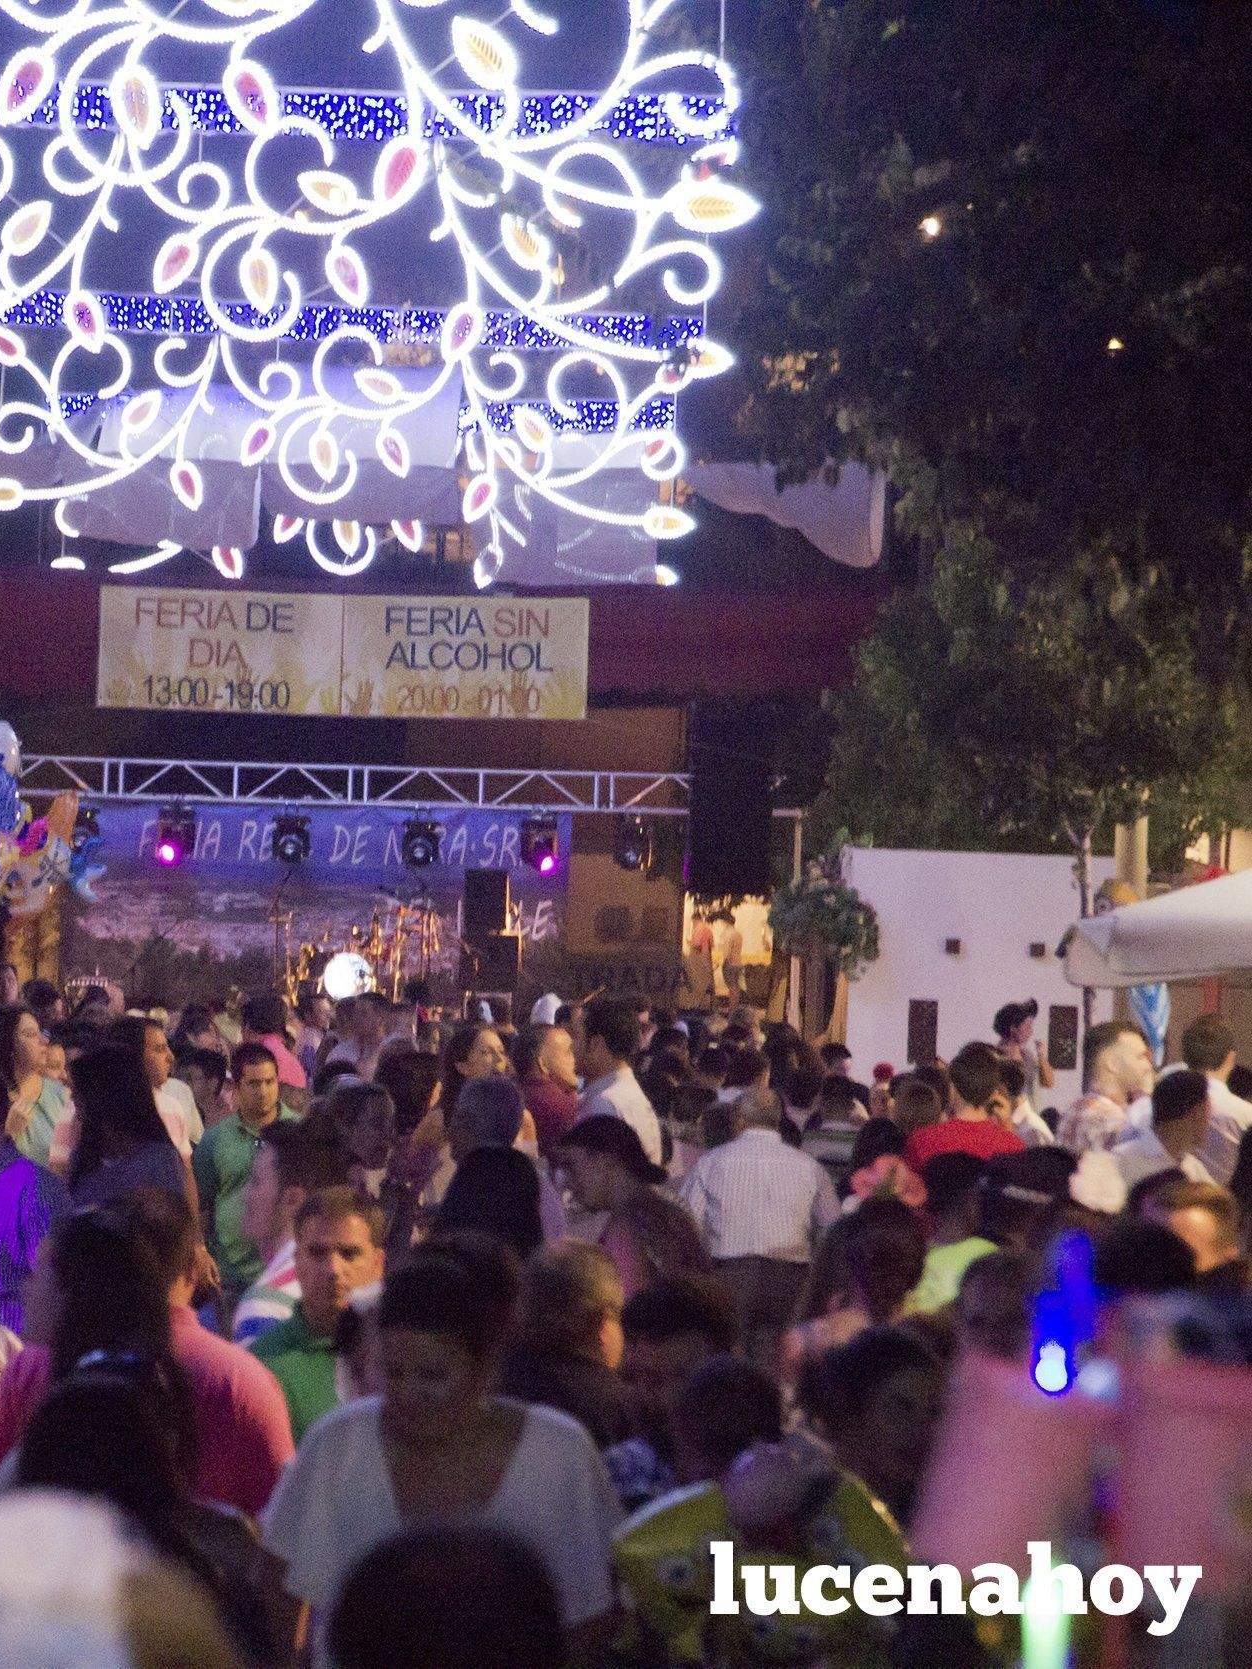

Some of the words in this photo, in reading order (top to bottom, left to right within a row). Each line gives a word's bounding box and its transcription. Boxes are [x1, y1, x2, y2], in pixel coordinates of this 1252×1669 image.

[135, 597, 237, 630] FERIA
[246, 601, 295, 633] DE
[384, 606, 486, 637] FERIA
[493, 608, 551, 638] SIN
[188, 638, 248, 669] DIA
[385, 641, 554, 672] ALCOHOL
[137, 818, 223, 860] FIA
[328, 823, 372, 865] DE
